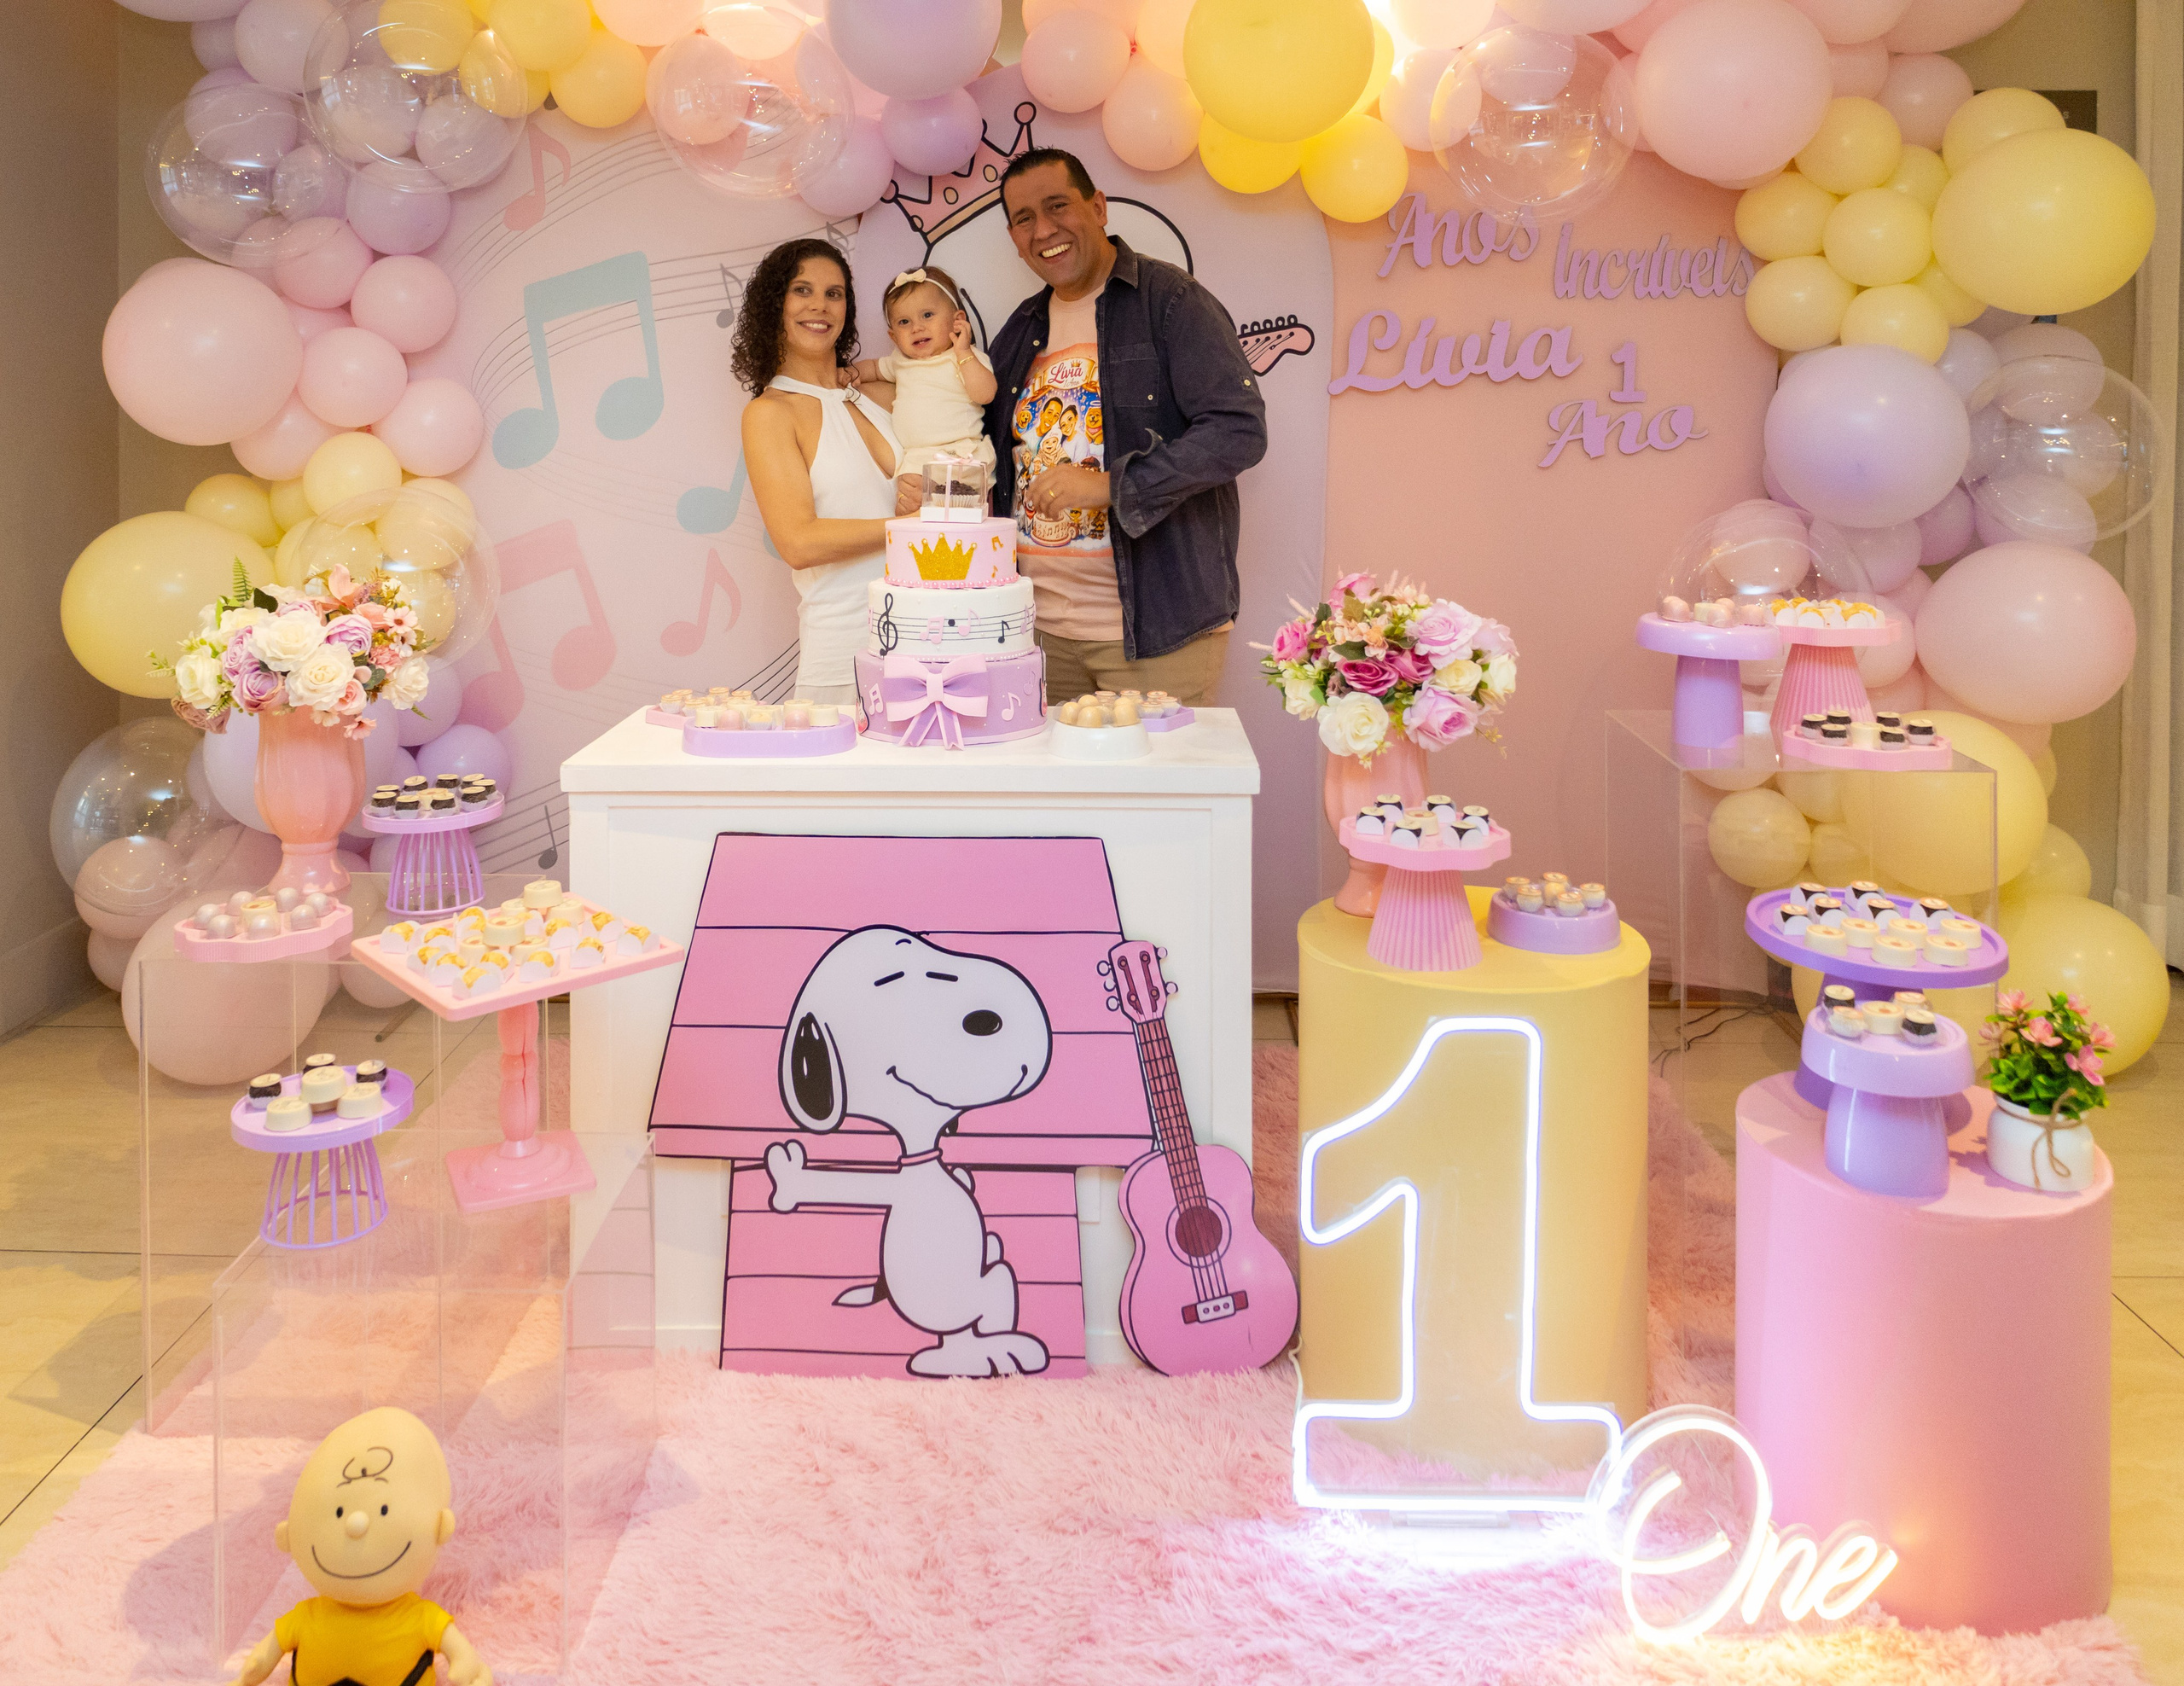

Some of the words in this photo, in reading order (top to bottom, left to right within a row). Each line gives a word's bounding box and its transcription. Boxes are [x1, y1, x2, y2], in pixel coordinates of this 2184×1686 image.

[1377, 191, 1539, 277] Anos
[1610, 341, 1647, 403] 1
[1537, 398, 1709, 468] Ano
[1292, 1015, 1624, 1512] 1
[1592, 1410, 1899, 1646] One
